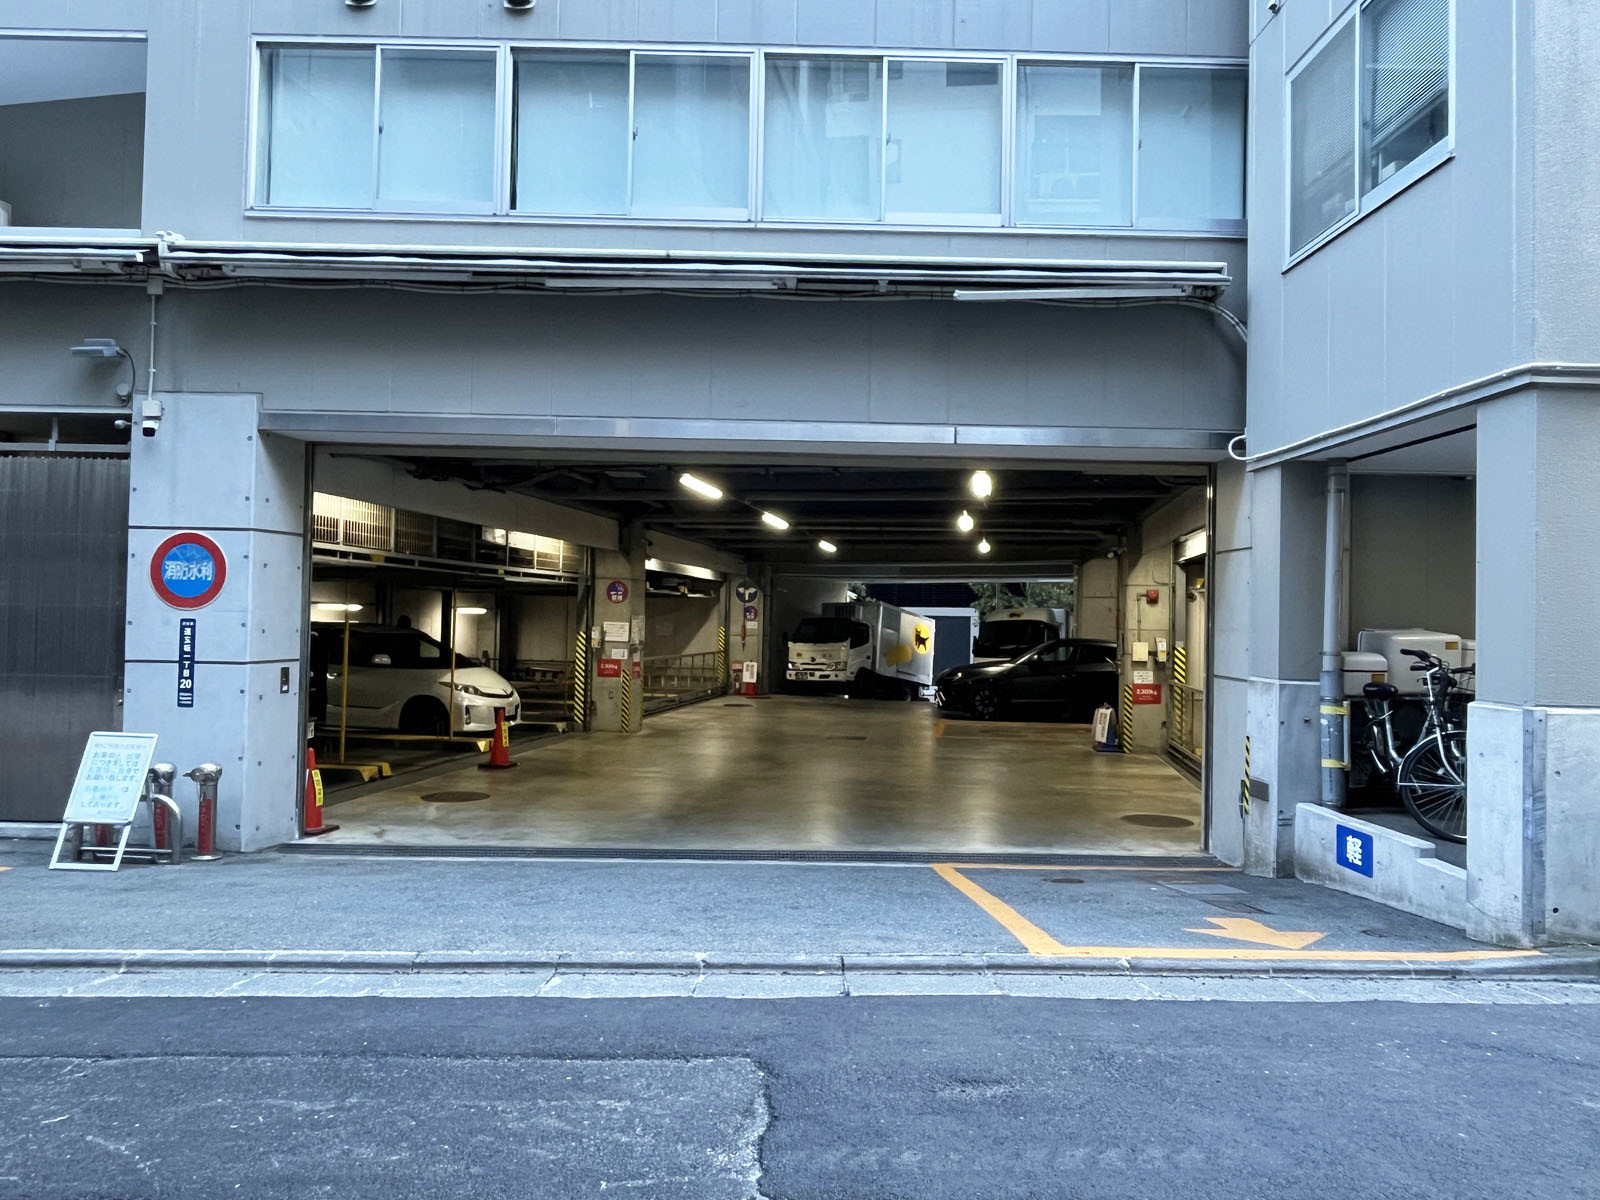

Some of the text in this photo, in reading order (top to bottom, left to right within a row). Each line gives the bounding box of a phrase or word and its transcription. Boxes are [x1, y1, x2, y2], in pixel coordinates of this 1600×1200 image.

[165, 560, 213, 581] 消防水利
[183, 628, 192, 677] 道玄坂一丁目
[179, 679, 192, 689] 20
[1347, 835, 1363, 866] 軽
